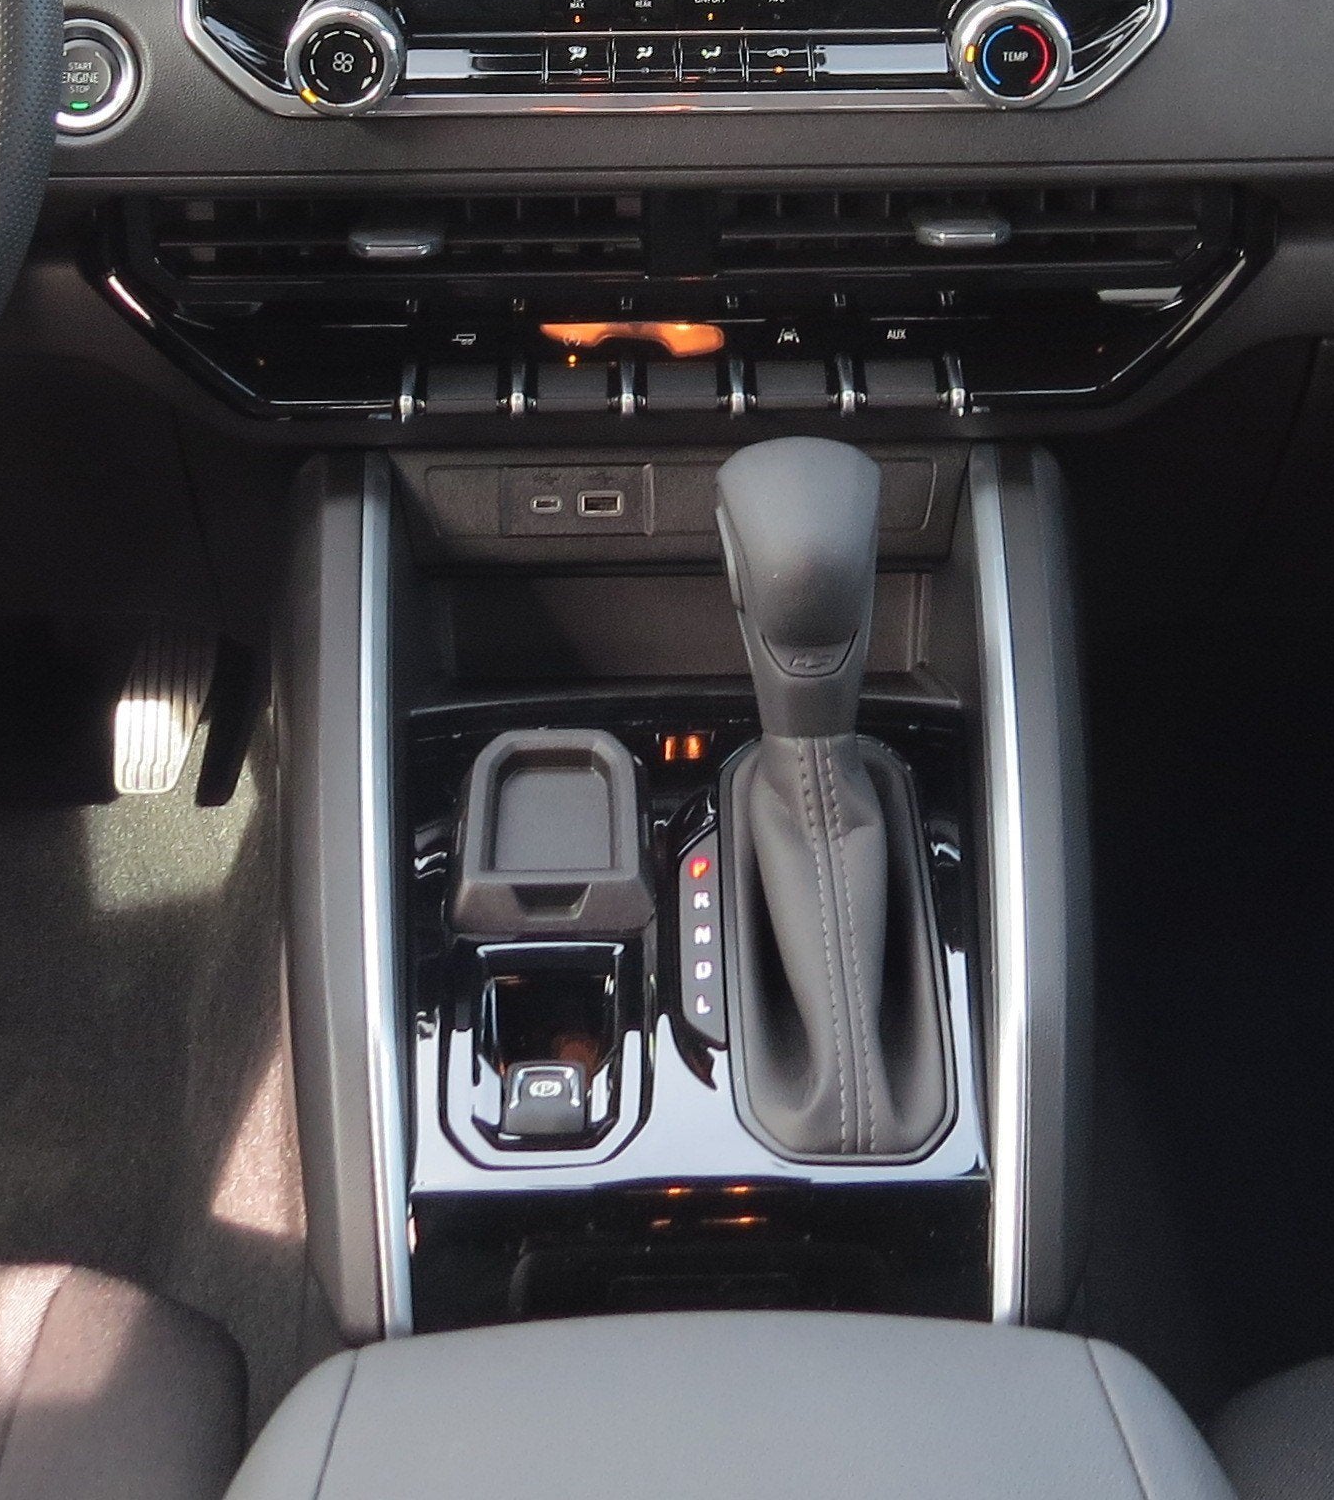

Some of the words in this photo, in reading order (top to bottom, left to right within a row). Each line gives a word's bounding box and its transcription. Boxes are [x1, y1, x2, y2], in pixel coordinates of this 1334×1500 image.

[1002, 51, 1029, 62] TEMP
[68, 62, 92, 70] START
[886, 329, 906, 340] AUX
[694, 925, 712, 944] N
[696, 995, 711, 1014] L
